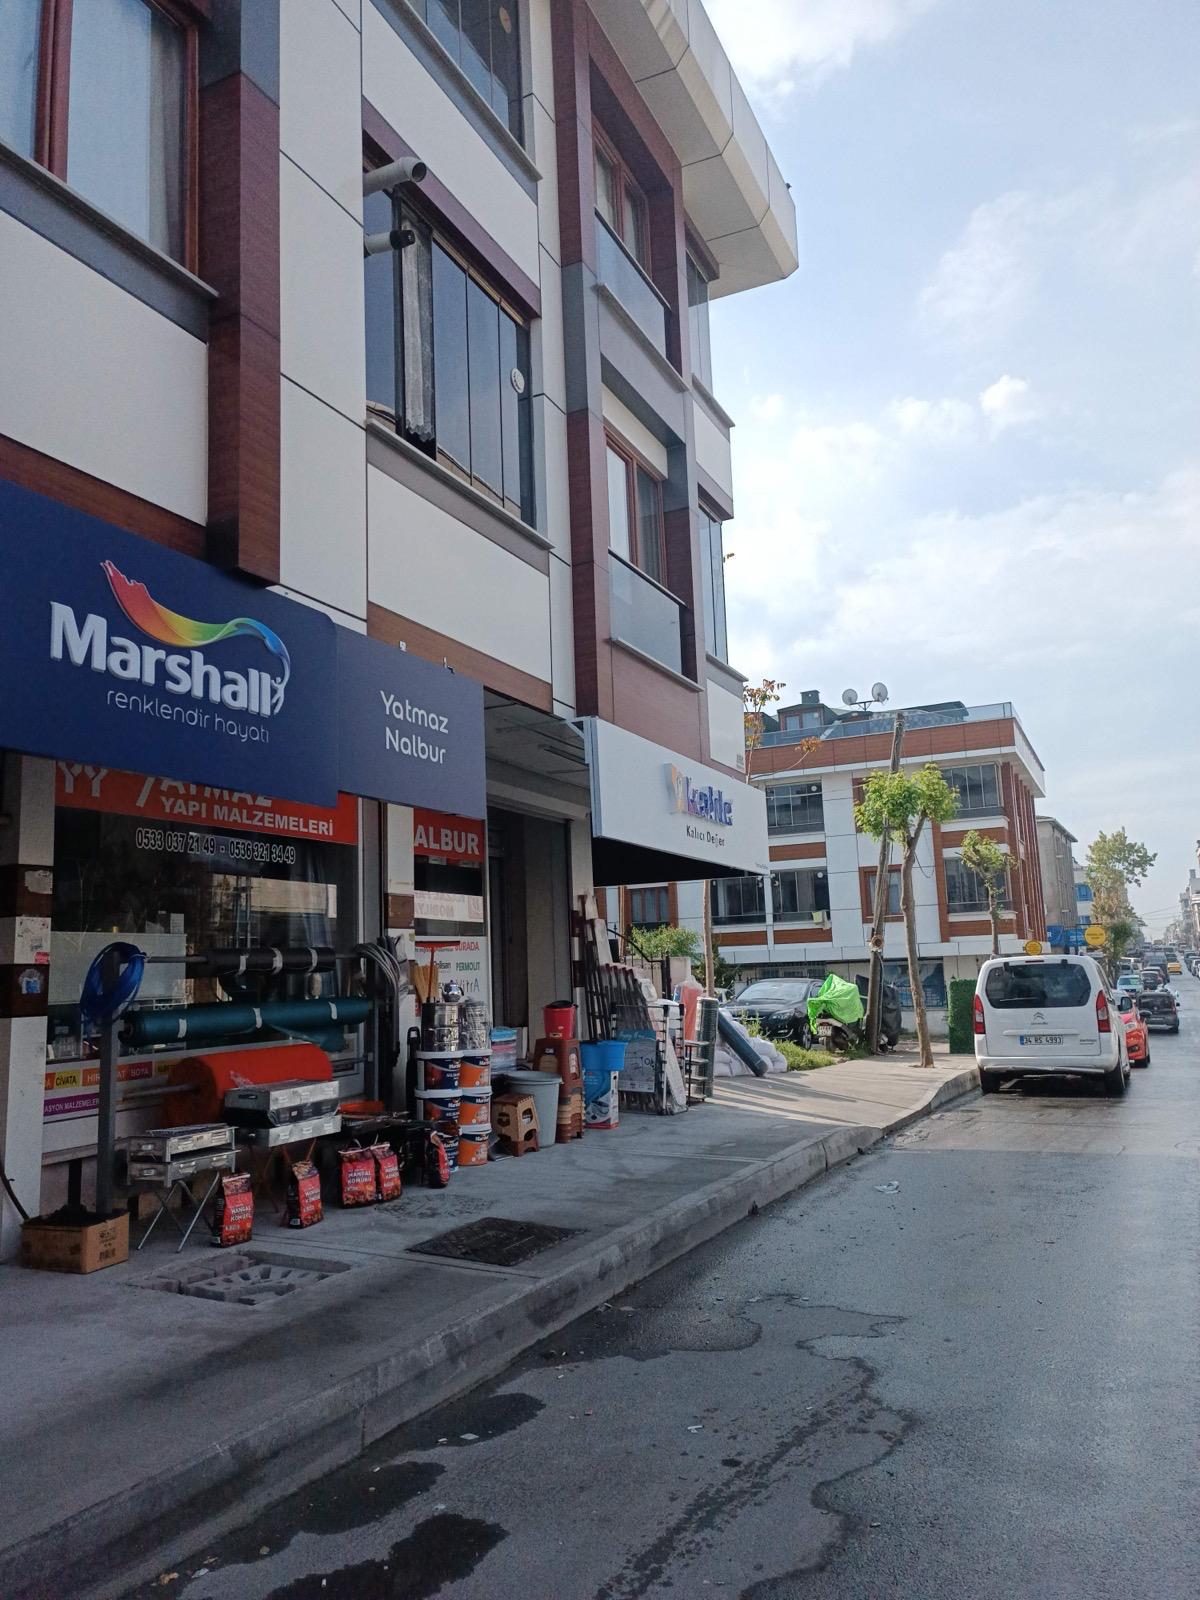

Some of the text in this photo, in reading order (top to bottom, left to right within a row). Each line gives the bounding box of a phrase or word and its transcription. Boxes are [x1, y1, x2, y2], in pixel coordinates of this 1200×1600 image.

[49, 601, 272, 719] Marshall
[107, 688, 270, 744] renklendir hayatı
[380, 690, 449, 734] Yatmaz
[385, 727, 447, 764] Nalbur
[160, 795, 334, 837] YAPI MALZEMELERİ
[135, 827, 165, 850] 0533
[166, 831, 186, 852] 037
[187, 831, 202, 853] 21
[202, 834, 216, 856] 49
[229, 838, 253, 861] 0536
[253, 841, 270, 862] 321
[271, 844, 284, 864] 34
[284, 846, 297, 865] 49
[414, 824, 480, 856] ALBUR
